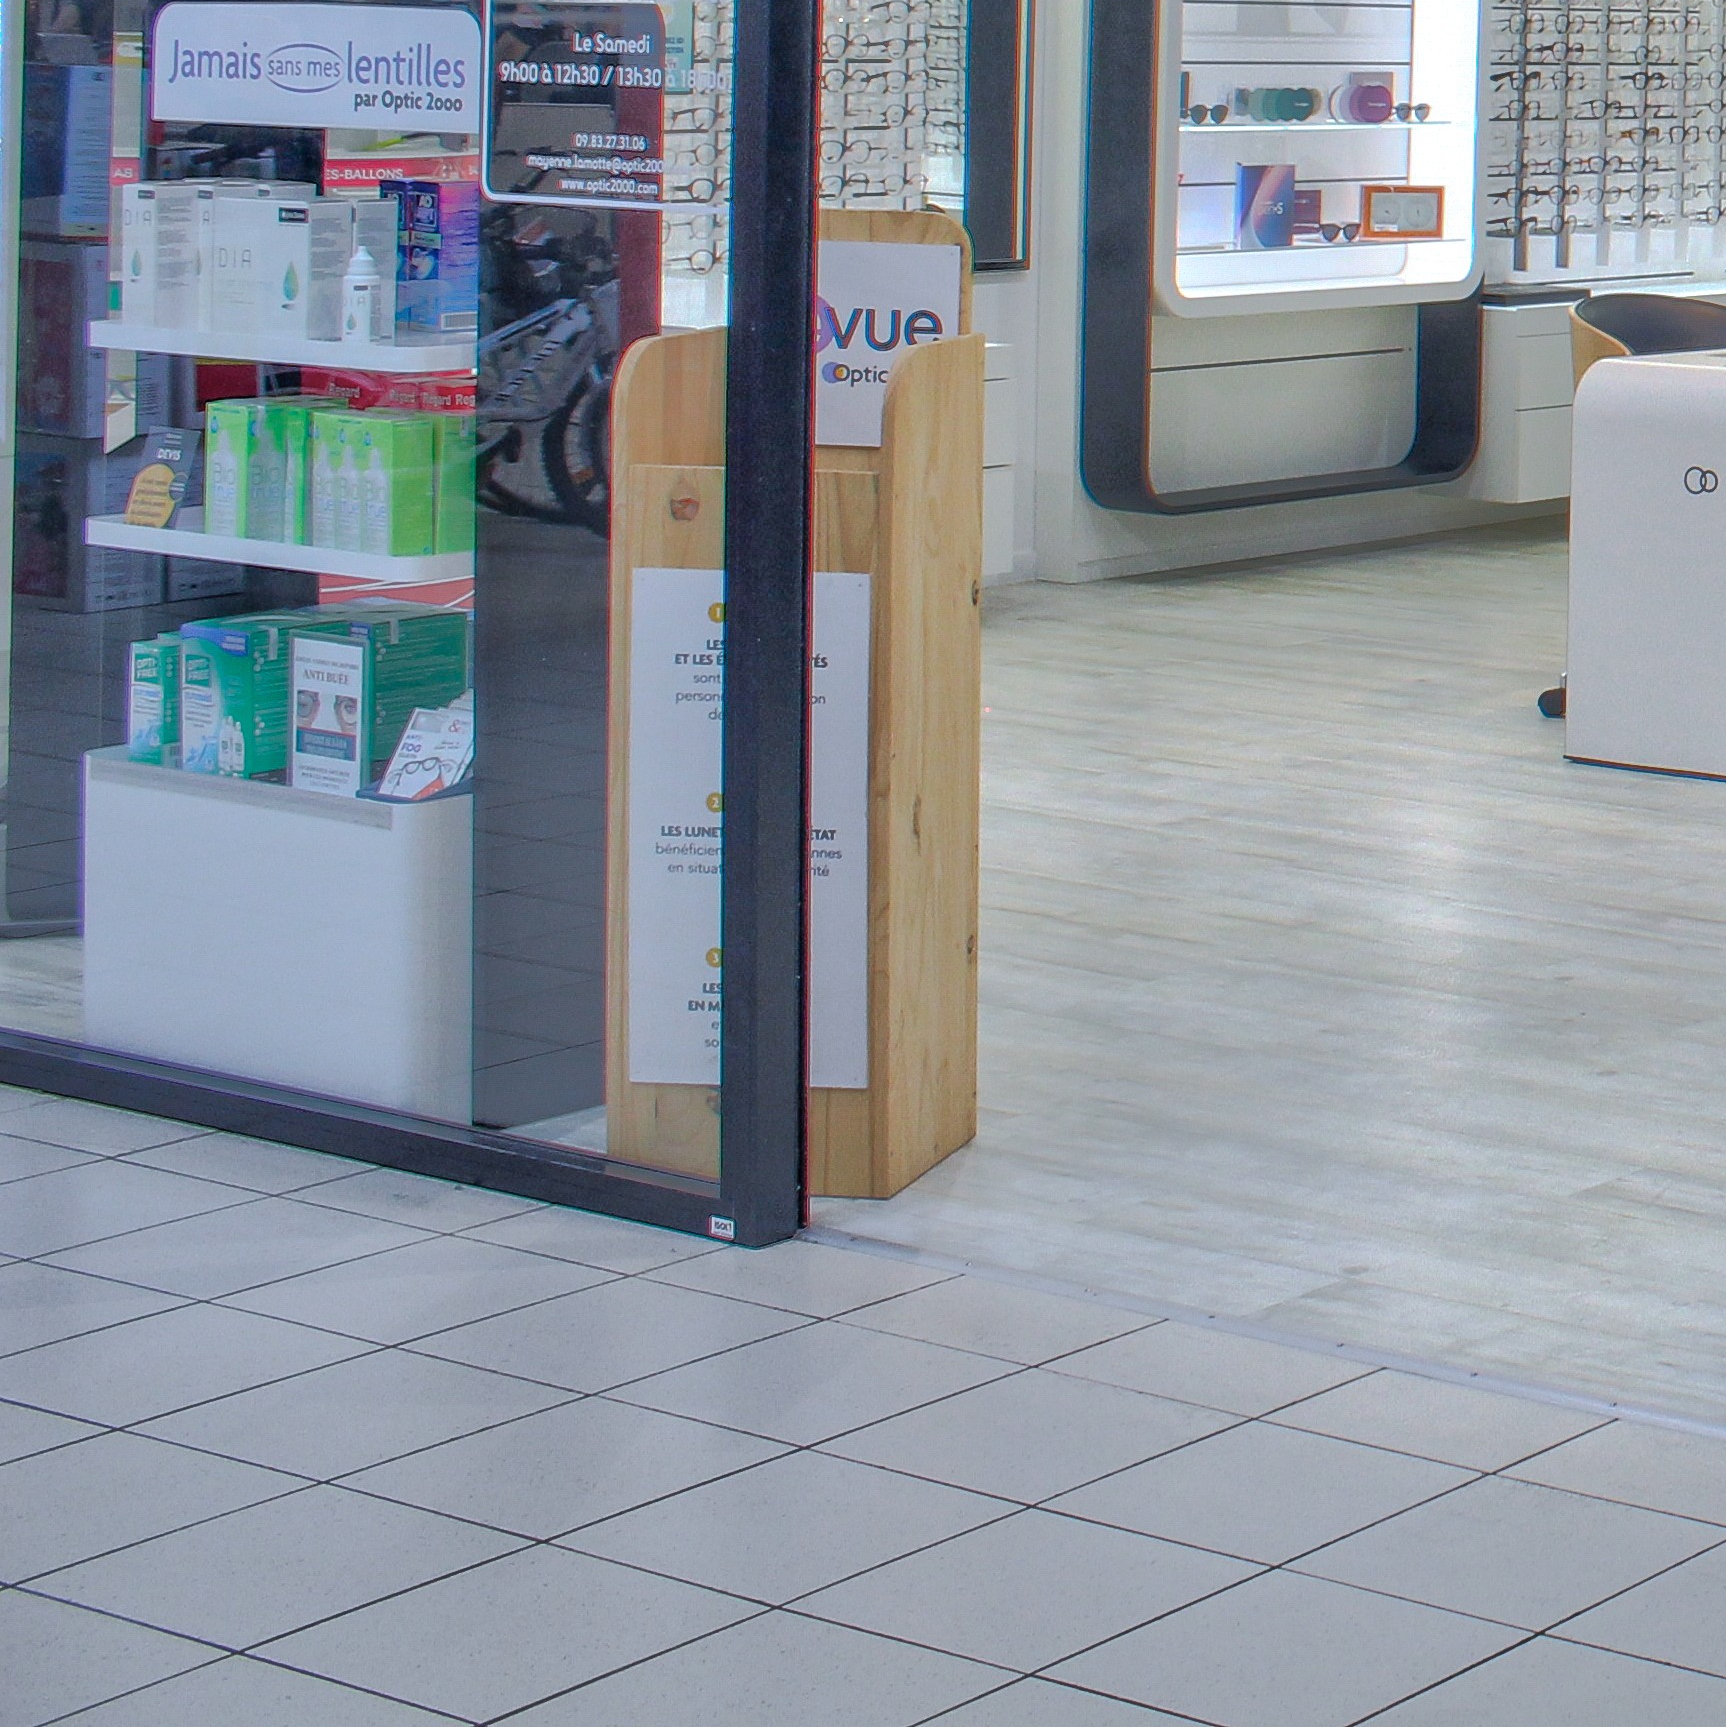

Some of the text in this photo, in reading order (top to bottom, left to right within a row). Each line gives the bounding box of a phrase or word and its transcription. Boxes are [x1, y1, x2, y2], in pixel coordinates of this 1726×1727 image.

[573, 32, 651, 54] Le Samedi
[168, 39, 465, 89] Jamais sans mes lentilles
[500, 62, 539, 83] 9h00
[541, 63, 552, 83] à
[554, 63, 599, 85] 12h30
[618, 67, 663, 87] 13h30
[354, 90, 463, 114] par Optic 2000
[833, 363, 889, 387] Optic
[675, 653, 690, 665] ET
[692, 654, 713, 666] LES
[661, 825, 682, 837] LES
[667, 864, 683, 873] en
[688, 1000, 705, 1012] EN
